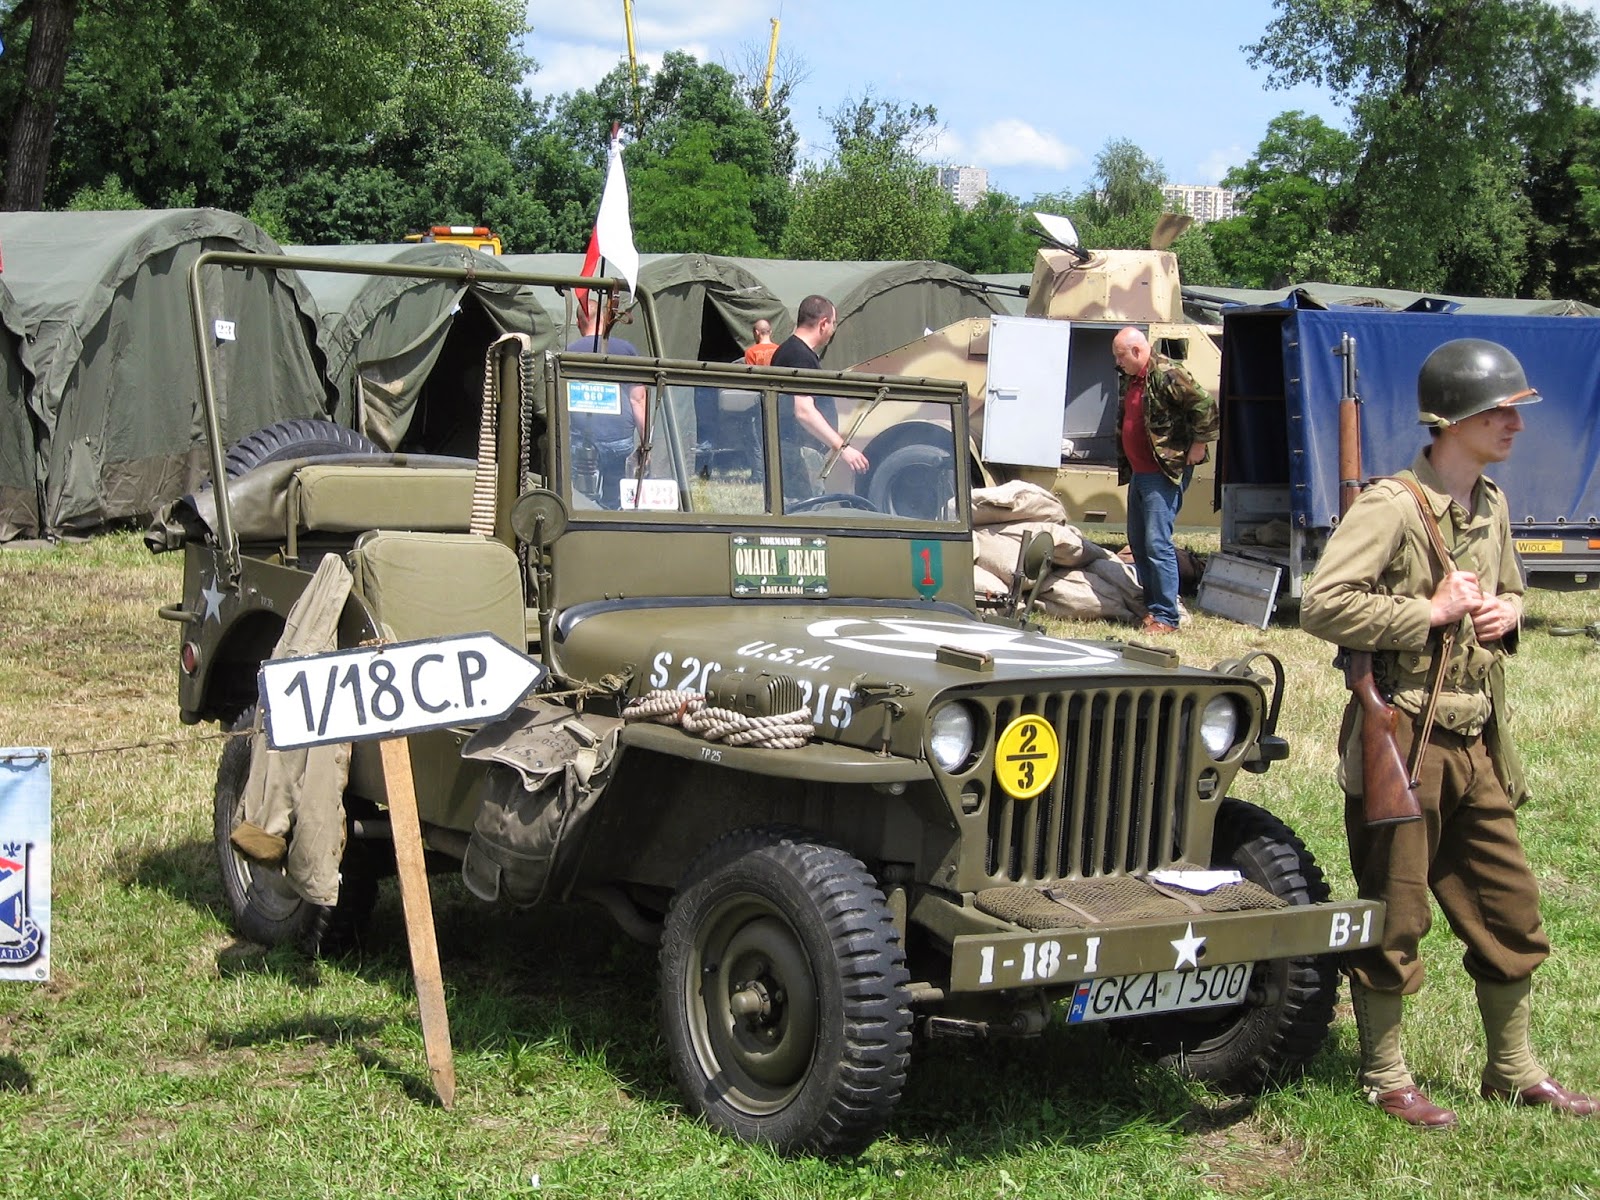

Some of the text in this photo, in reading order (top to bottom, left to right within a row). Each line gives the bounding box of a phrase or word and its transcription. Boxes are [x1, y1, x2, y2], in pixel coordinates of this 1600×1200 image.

[759, 536, 802, 546] NORMANDIE
[735, 548, 827, 576] OMAHA BEACH
[919, 547, 936, 586] 1
[737, 640, 835, 672] U.S.A.
[284, 650, 488, 736] 1/18 C.P.
[1019, 724, 1038, 753] 2
[1017, 761, 1034, 790] 3
[1328, 909, 1372, 948] B-1
[1092, 963, 1247, 1015] GKA T500
[1071, 1004, 1083, 1015] PL
